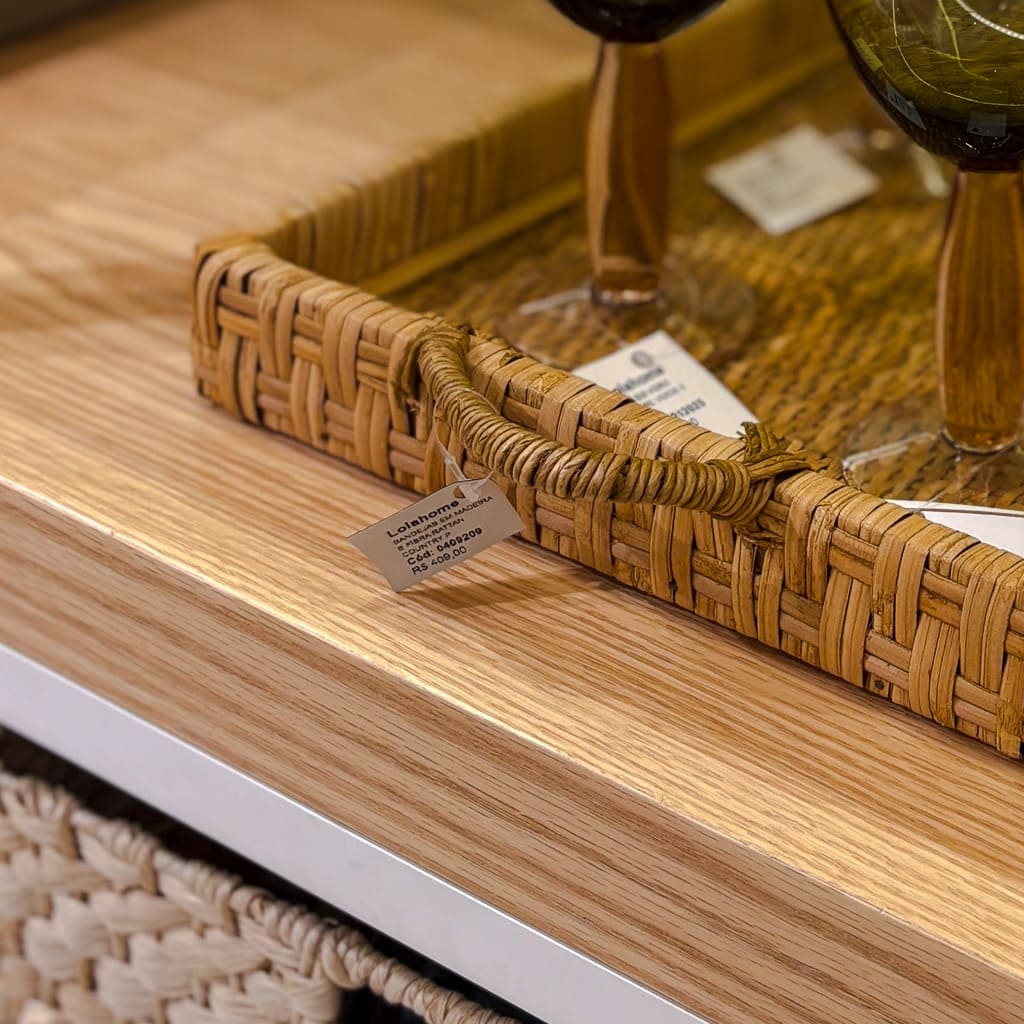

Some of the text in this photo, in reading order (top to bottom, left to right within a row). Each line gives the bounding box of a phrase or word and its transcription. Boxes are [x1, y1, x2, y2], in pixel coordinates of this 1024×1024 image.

[386, 500, 460, 538] Lolahome
[393, 495, 494, 545] BANDEJAS EM MADEIRA
[402, 531, 452, 558] COUNTRY P
[407, 527, 483, 565] Cód: 0409209
